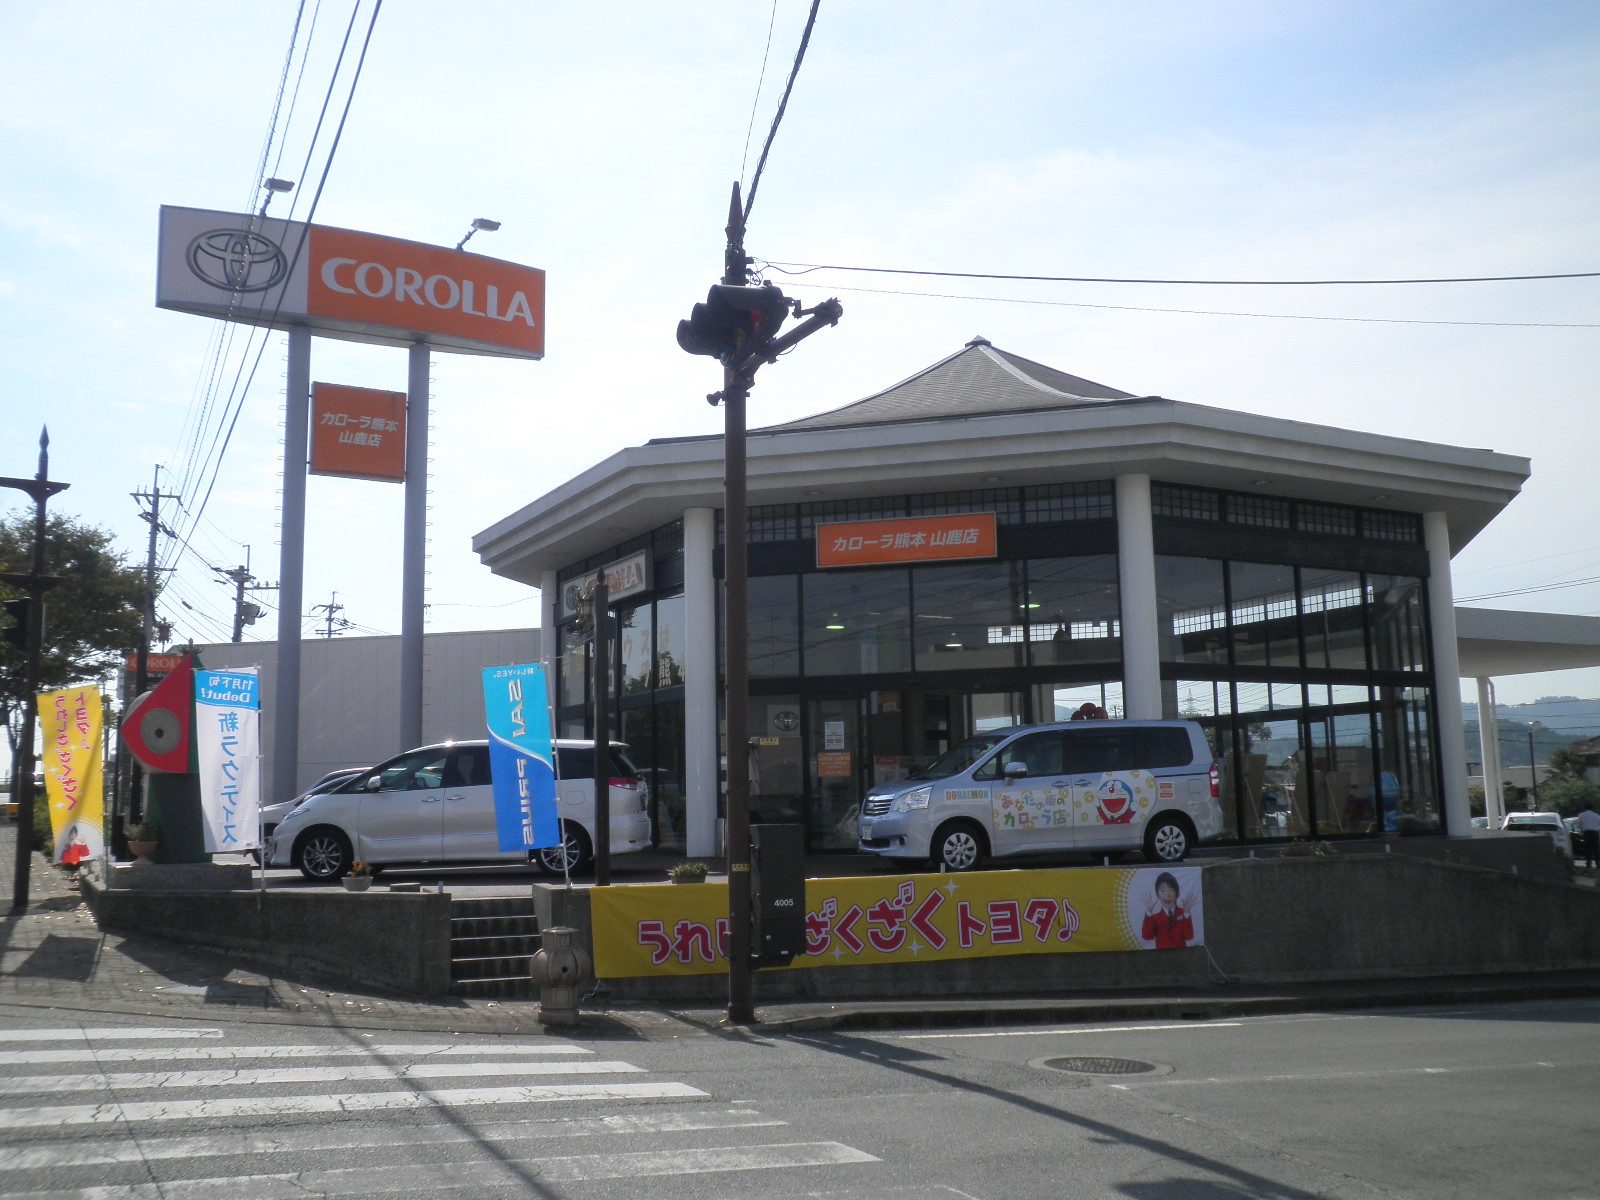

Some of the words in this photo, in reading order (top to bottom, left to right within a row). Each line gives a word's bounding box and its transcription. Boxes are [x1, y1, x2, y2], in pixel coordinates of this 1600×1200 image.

[321, 256, 535, 328] COROLLA
[320, 410, 399, 433] カローラ熊本
[338, 430, 382, 449] 山鹿店
[832, 531, 926, 552] カローラ熊本
[930, 527, 979, 547] 山鹿店
[945, 789, 989, 801] DORAEMON
[1001, 793, 1065, 812] あなたの街の
[1004, 809, 1068, 827] カローラ店
[774, 899, 794, 907] 4005
